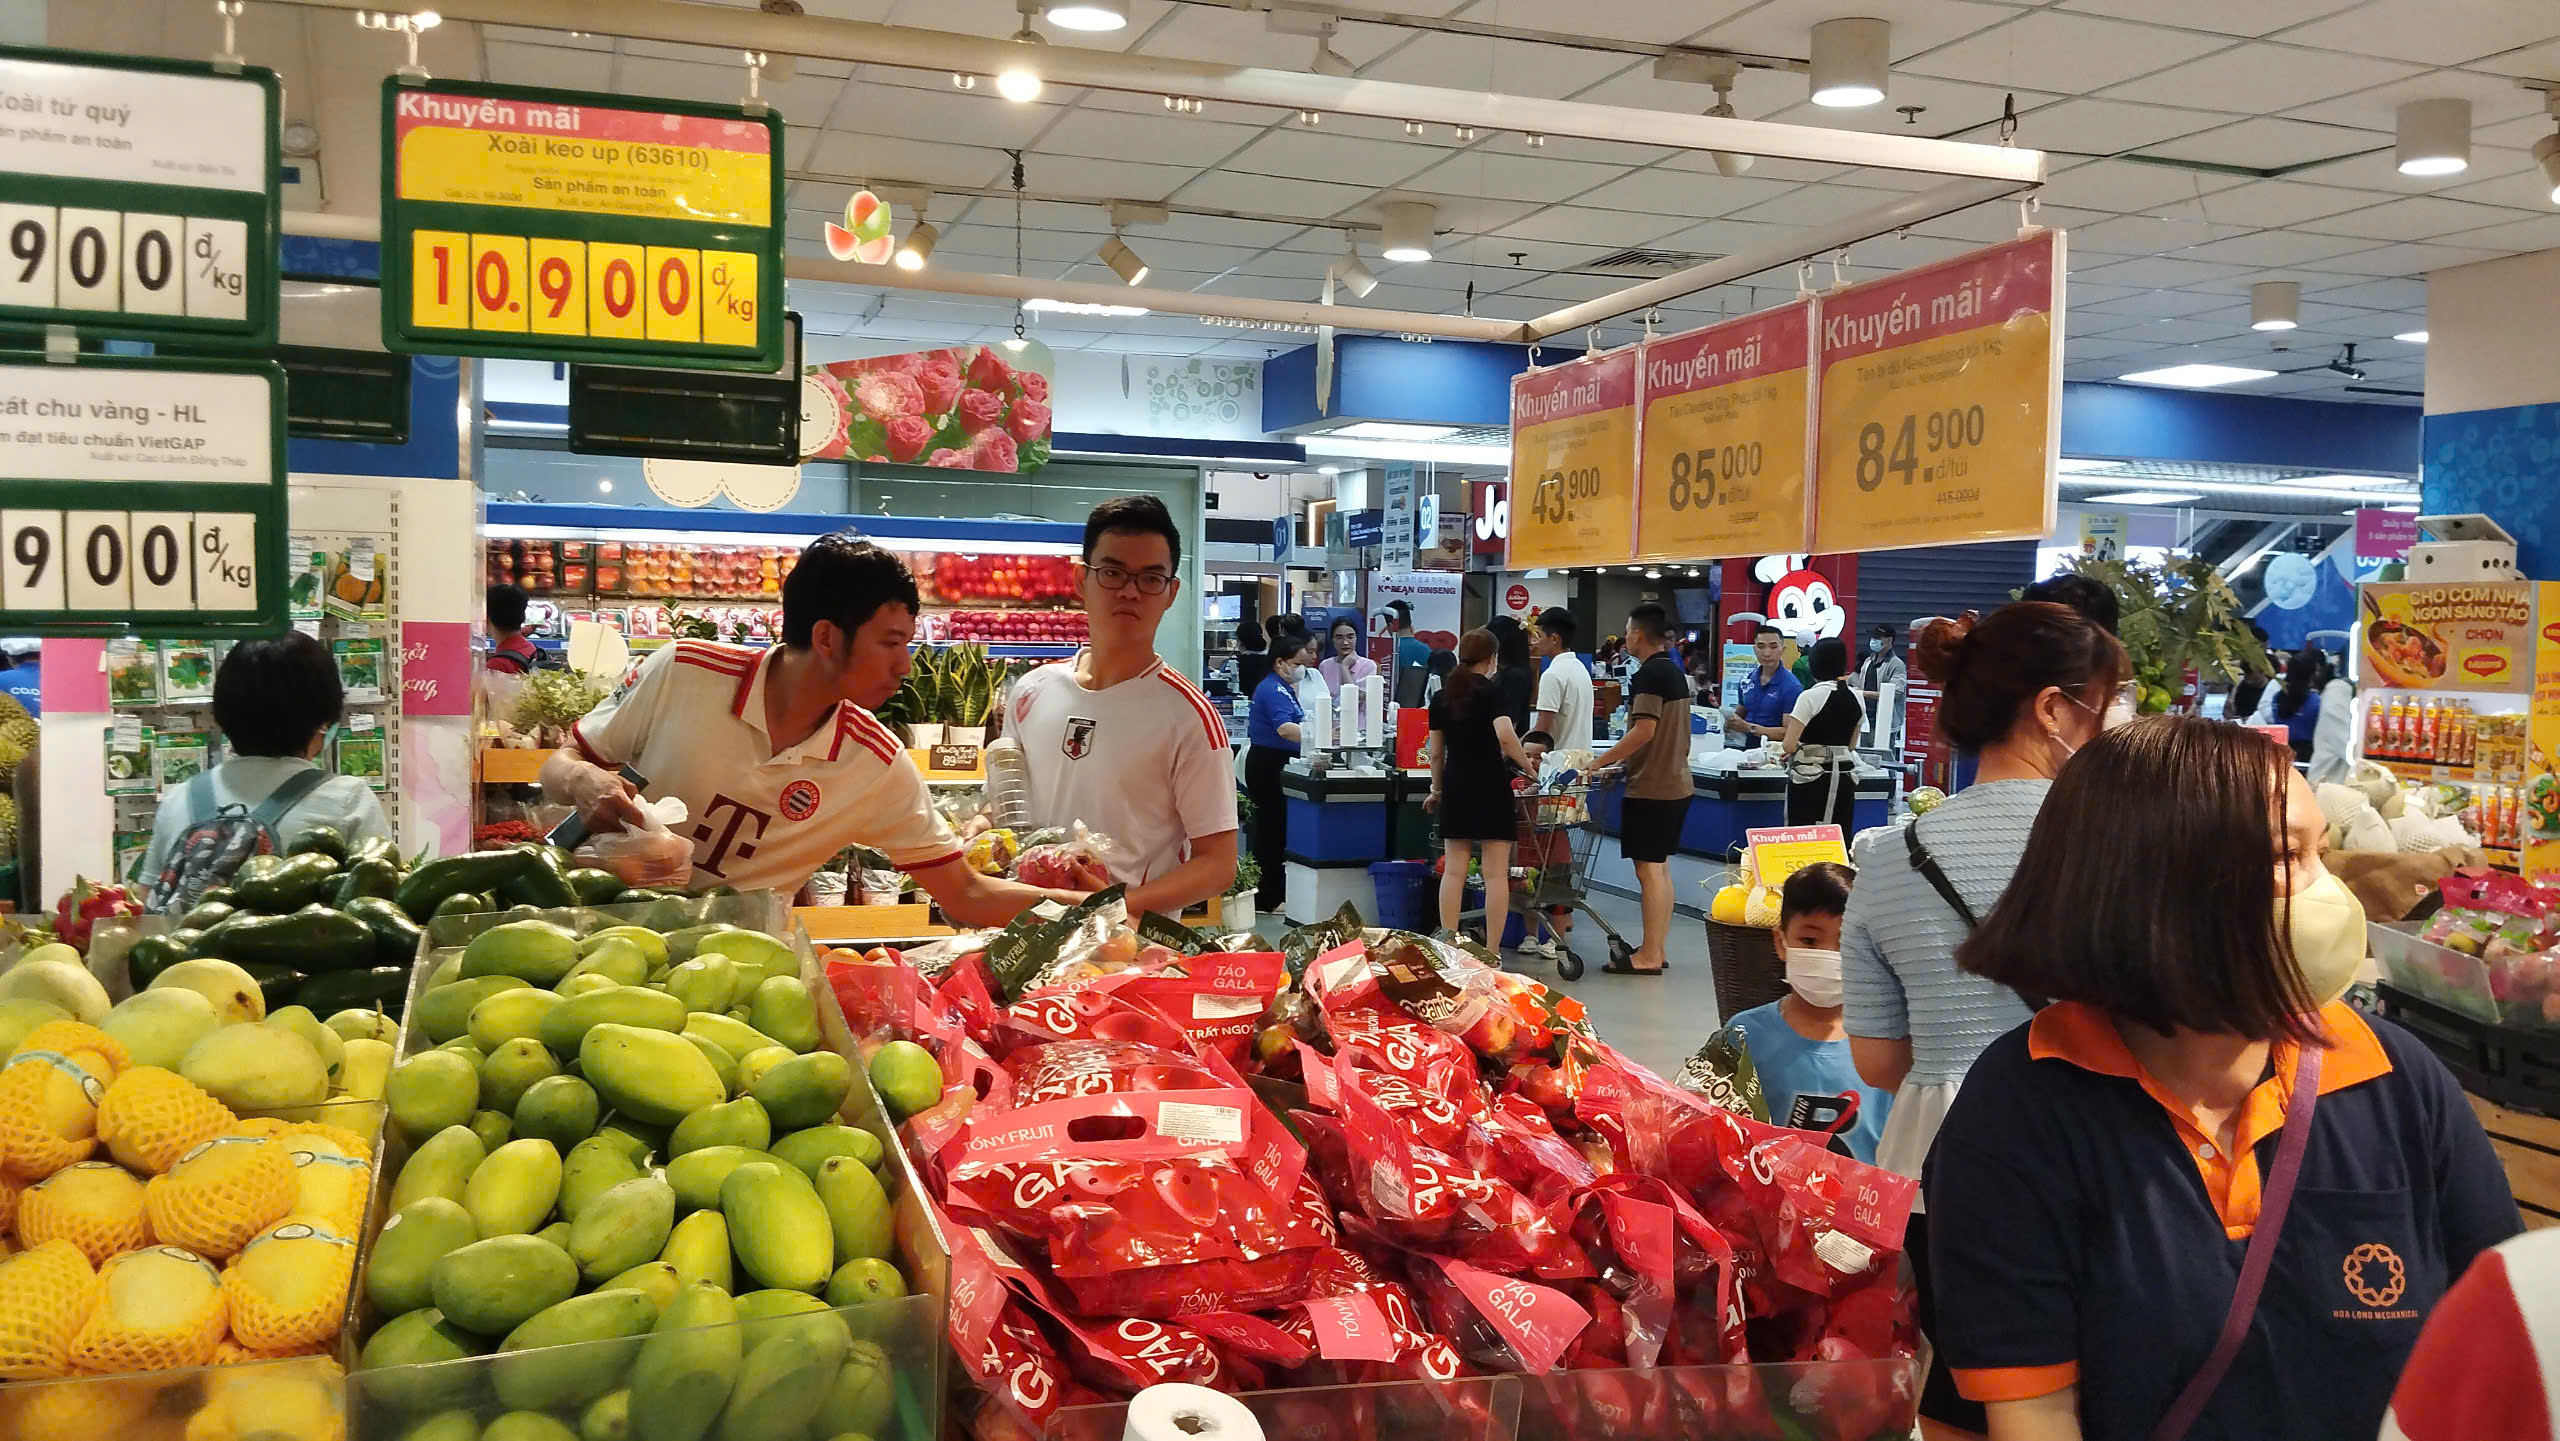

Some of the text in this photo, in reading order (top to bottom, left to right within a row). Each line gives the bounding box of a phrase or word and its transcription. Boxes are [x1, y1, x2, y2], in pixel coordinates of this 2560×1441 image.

[0, 91, 42, 112] oài
[85, 103, 131, 127] quý
[526, 107, 580, 131] mãi
[487, 134, 710, 171] Xoài keo up (63610)
[612, 184, 632, 196] an
[1825, 276, 1983, 351] Khuyến mãi
[1647, 335, 1762, 390] Khuyến mãi
[36, 398, 81, 418] chu
[90, 399, 149, 426] vàng
[173, 403, 206, 424] HL
[1516, 377, 1600, 420] Khuyến mãi
[137, 435, 206, 450] VietGAP
[1421, 505, 1432, 530] 02
[1417, 586, 1456, 594] GINSENG
[2465, 628, 2504, 642] CHỌN
[1213, 977, 1256, 990] GALA
[1215, 964, 1247, 978] TÁO
[964, 1124, 1056, 1153] TÓNY FRUIT
[1264, 1141, 1281, 1169] TÁO
[1253, 1158, 1280, 1192] GALA
[1858, 1185, 1879, 1206] TÁO
[1853, 1206, 1881, 1229] GALA
[953, 1278, 976, 1308] TÁO
[1502, 1279, 1536, 1307] TÁO
[1488, 1288, 1534, 1338] GALA
[2352, 1310, 2373, 1320] LONG
[2375, 1310, 2418, 1320] MECHANICAL
